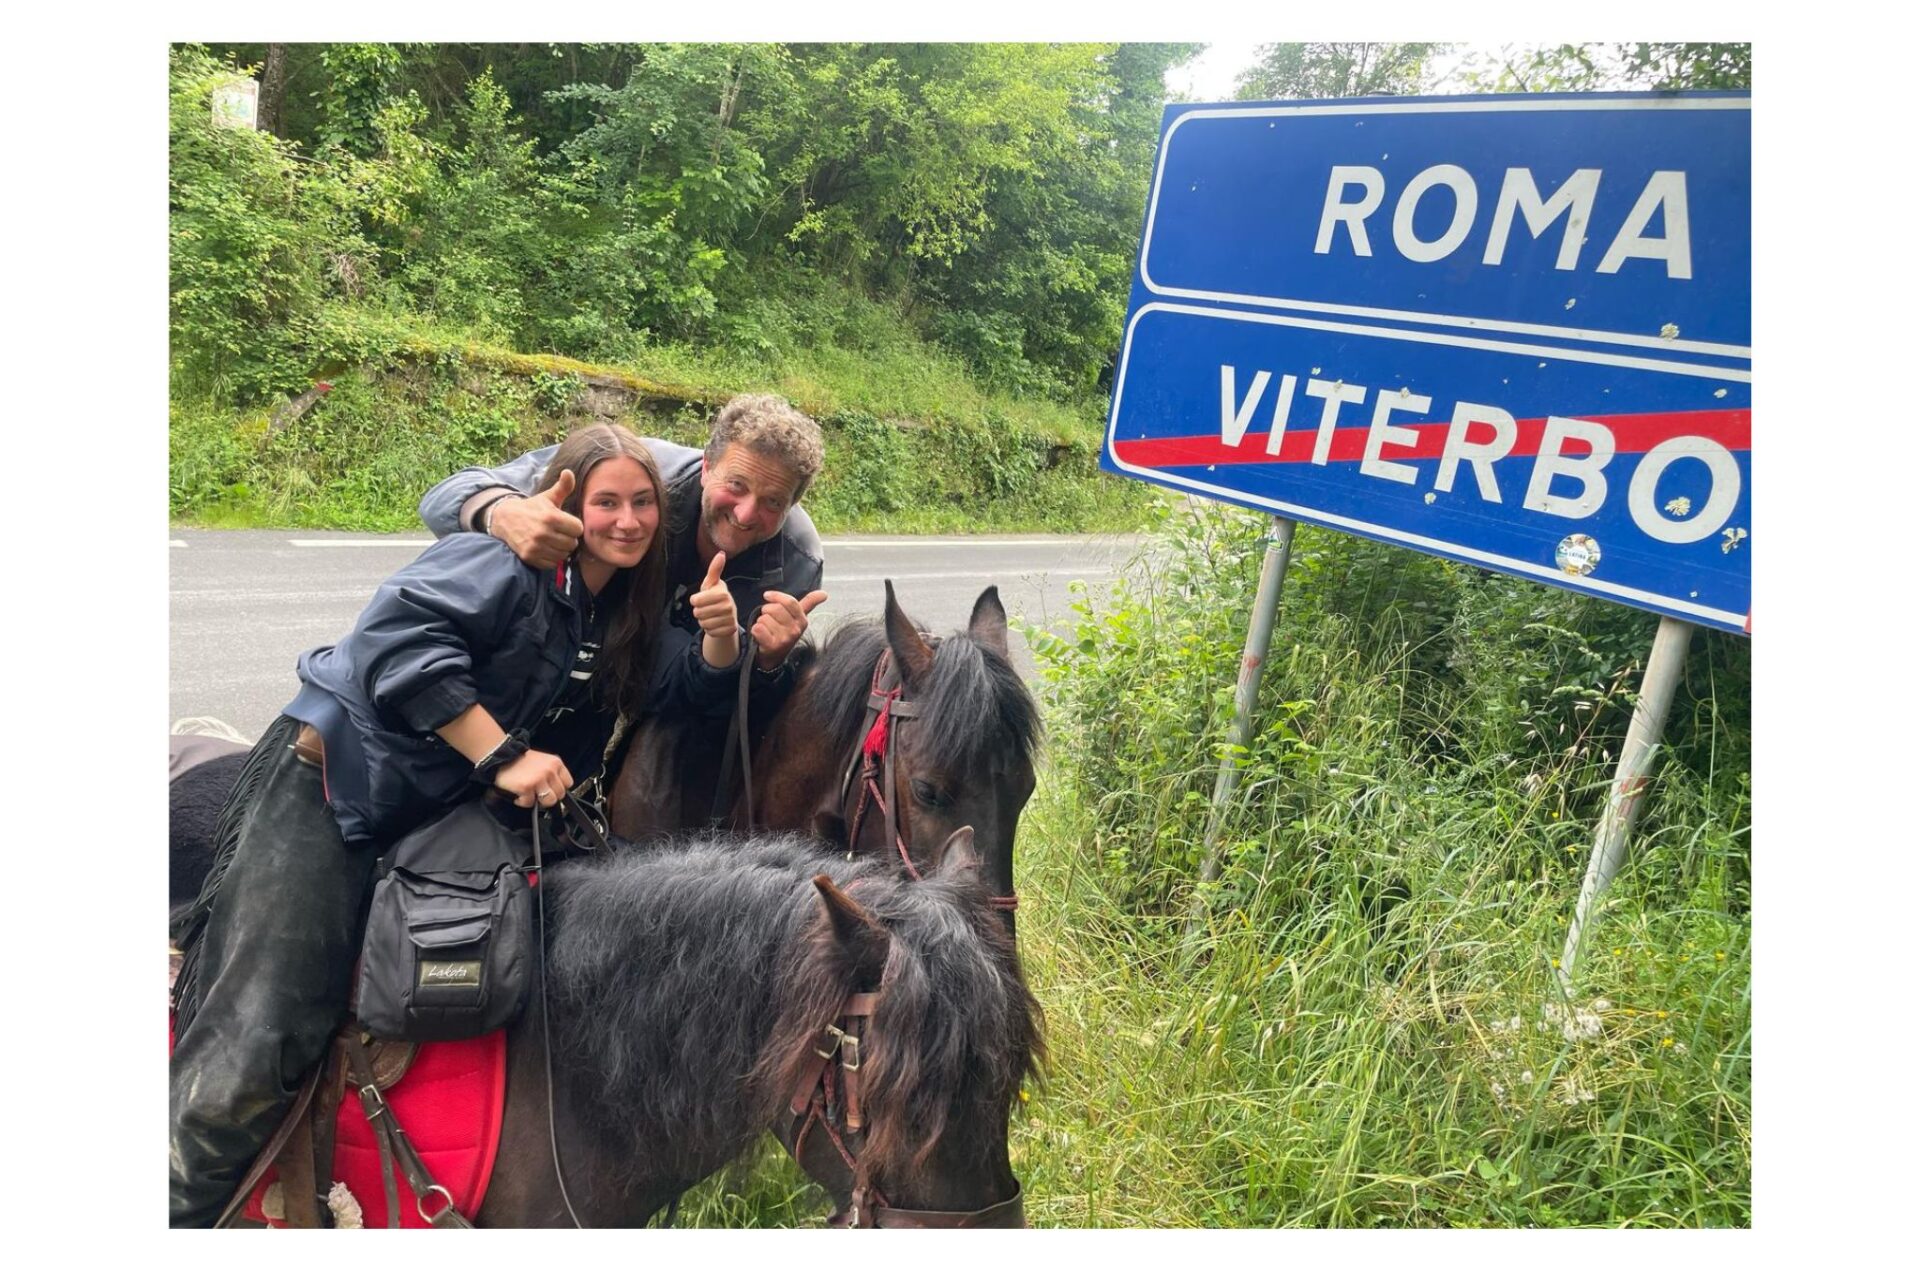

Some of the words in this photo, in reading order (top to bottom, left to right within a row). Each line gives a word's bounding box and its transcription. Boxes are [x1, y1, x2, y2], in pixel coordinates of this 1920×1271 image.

[1313, 164, 1693, 280] ROMA
[1219, 365, 1742, 544] VITERBO
[428, 963, 468, 977] Lakota
